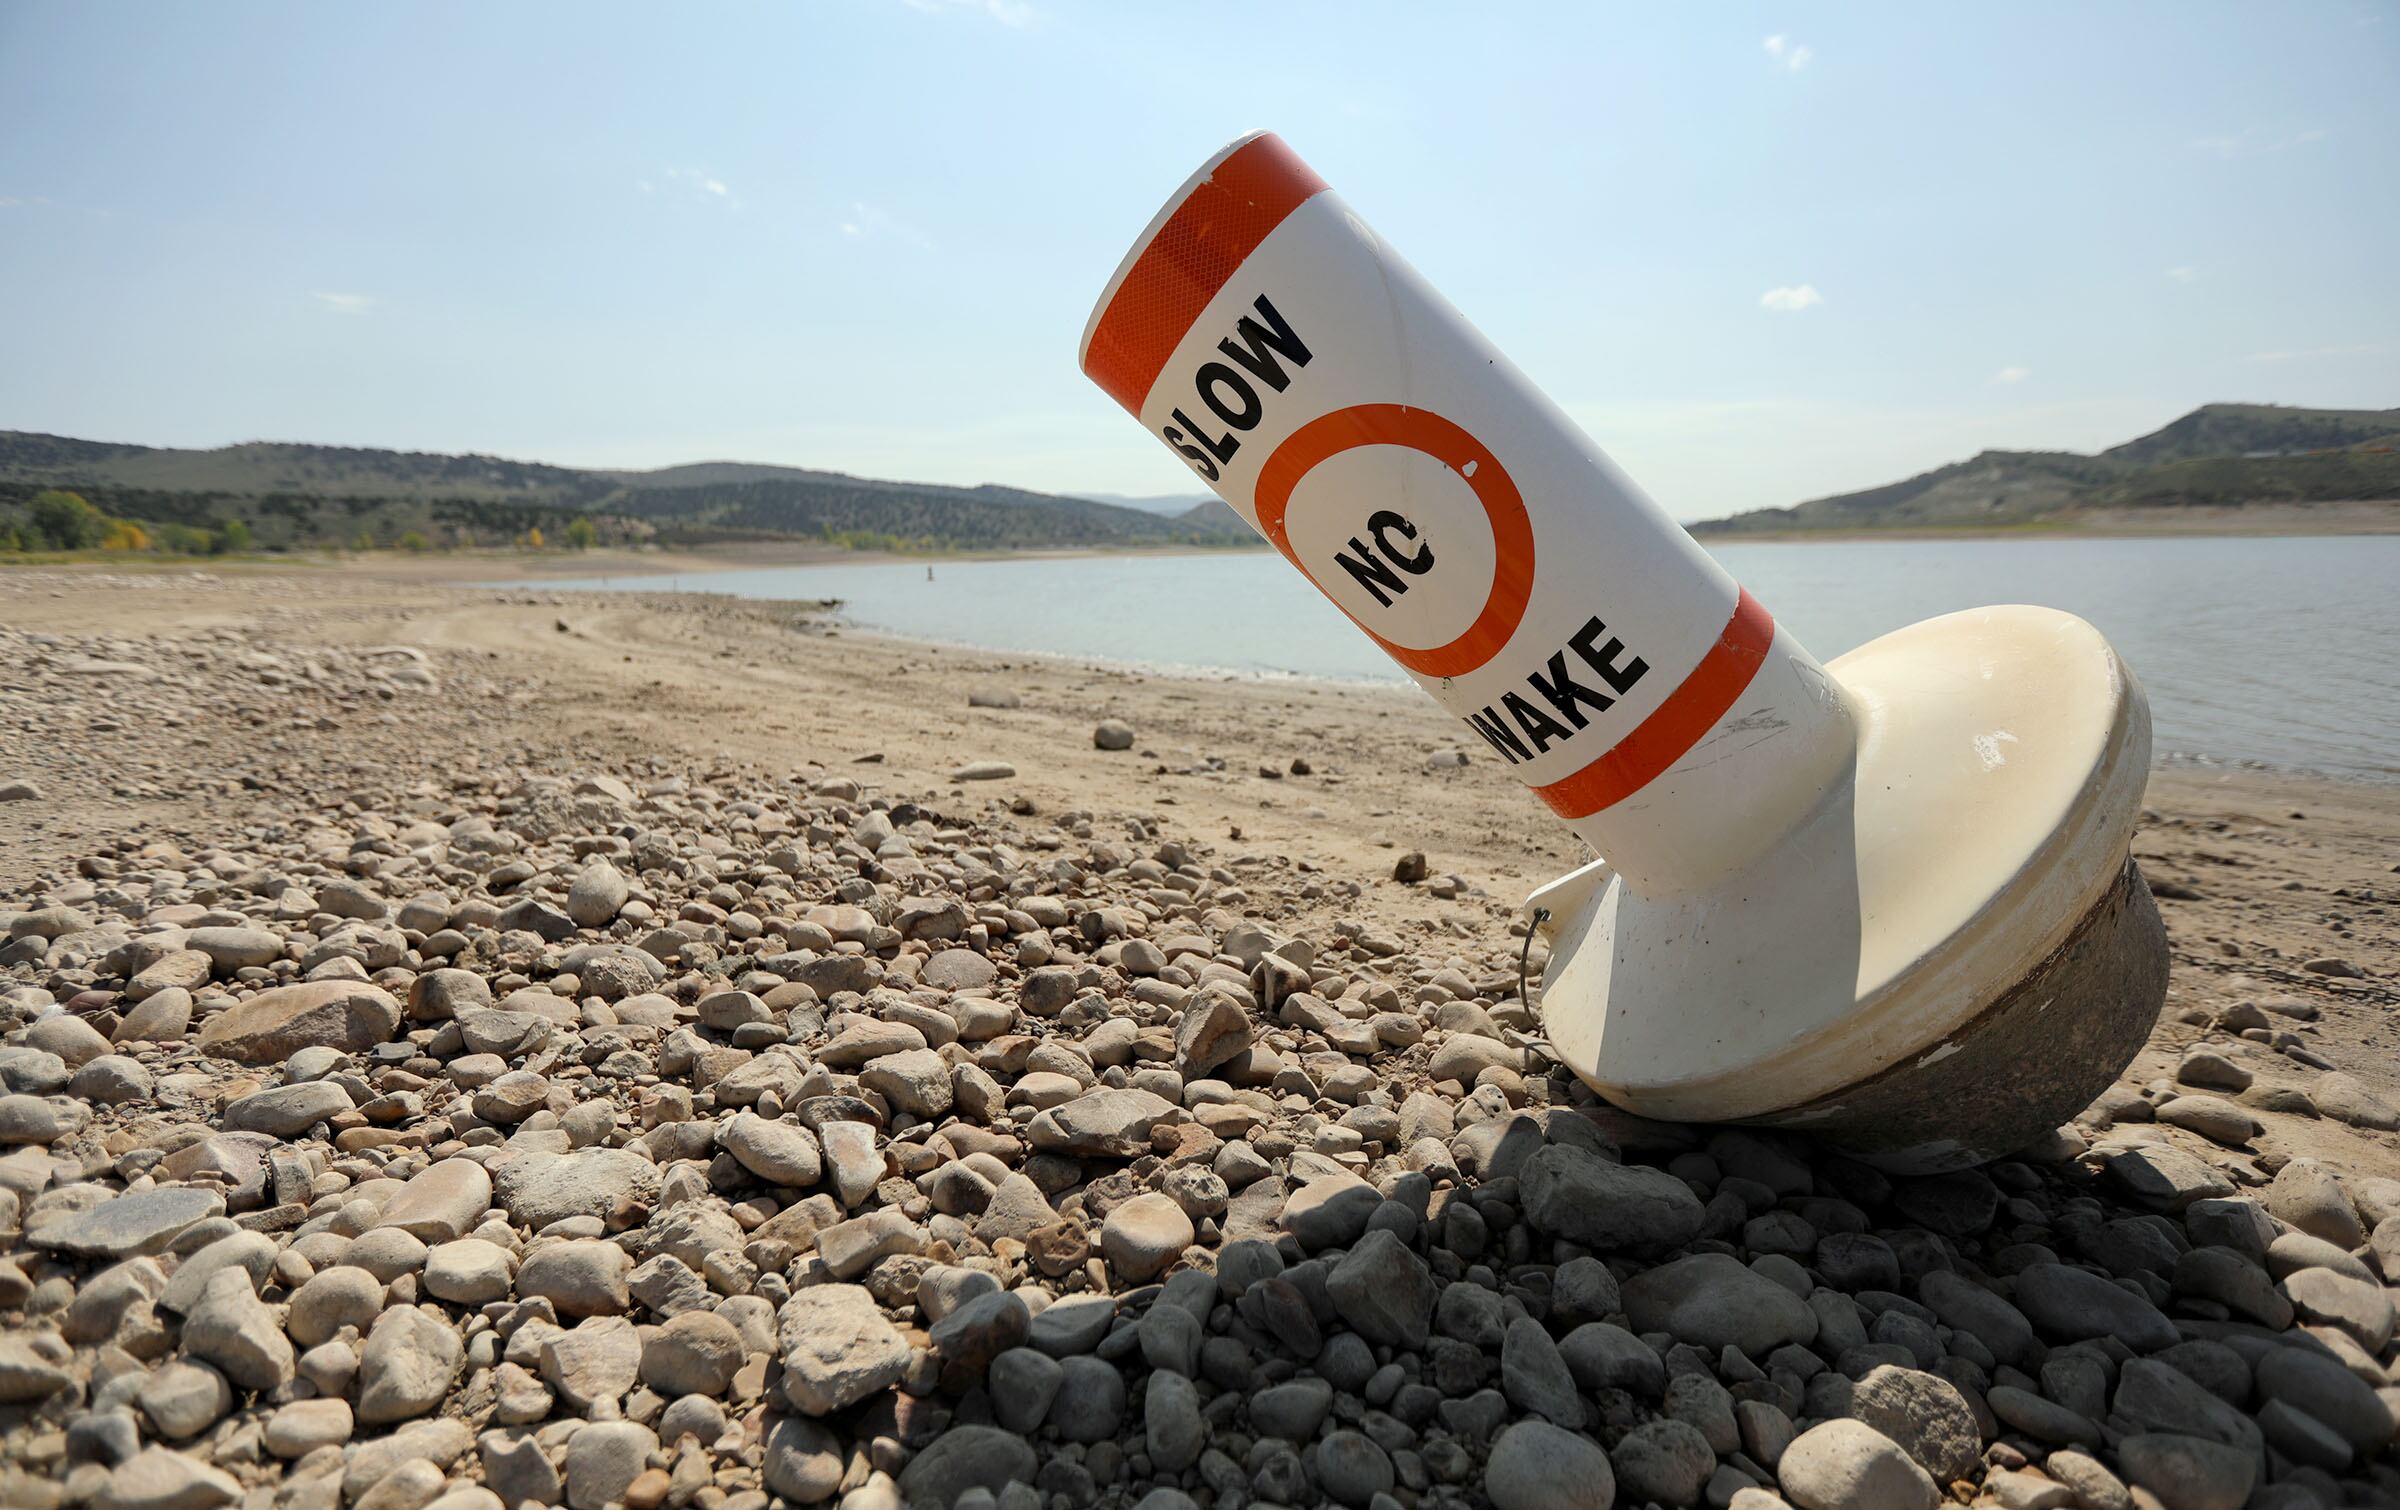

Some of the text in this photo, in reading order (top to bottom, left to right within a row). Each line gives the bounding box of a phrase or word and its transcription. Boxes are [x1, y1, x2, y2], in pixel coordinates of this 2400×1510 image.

[1163, 293, 1314, 482] SLOW
[1333, 510, 1435, 609] NO
[1462, 615, 1651, 765] WAKE
